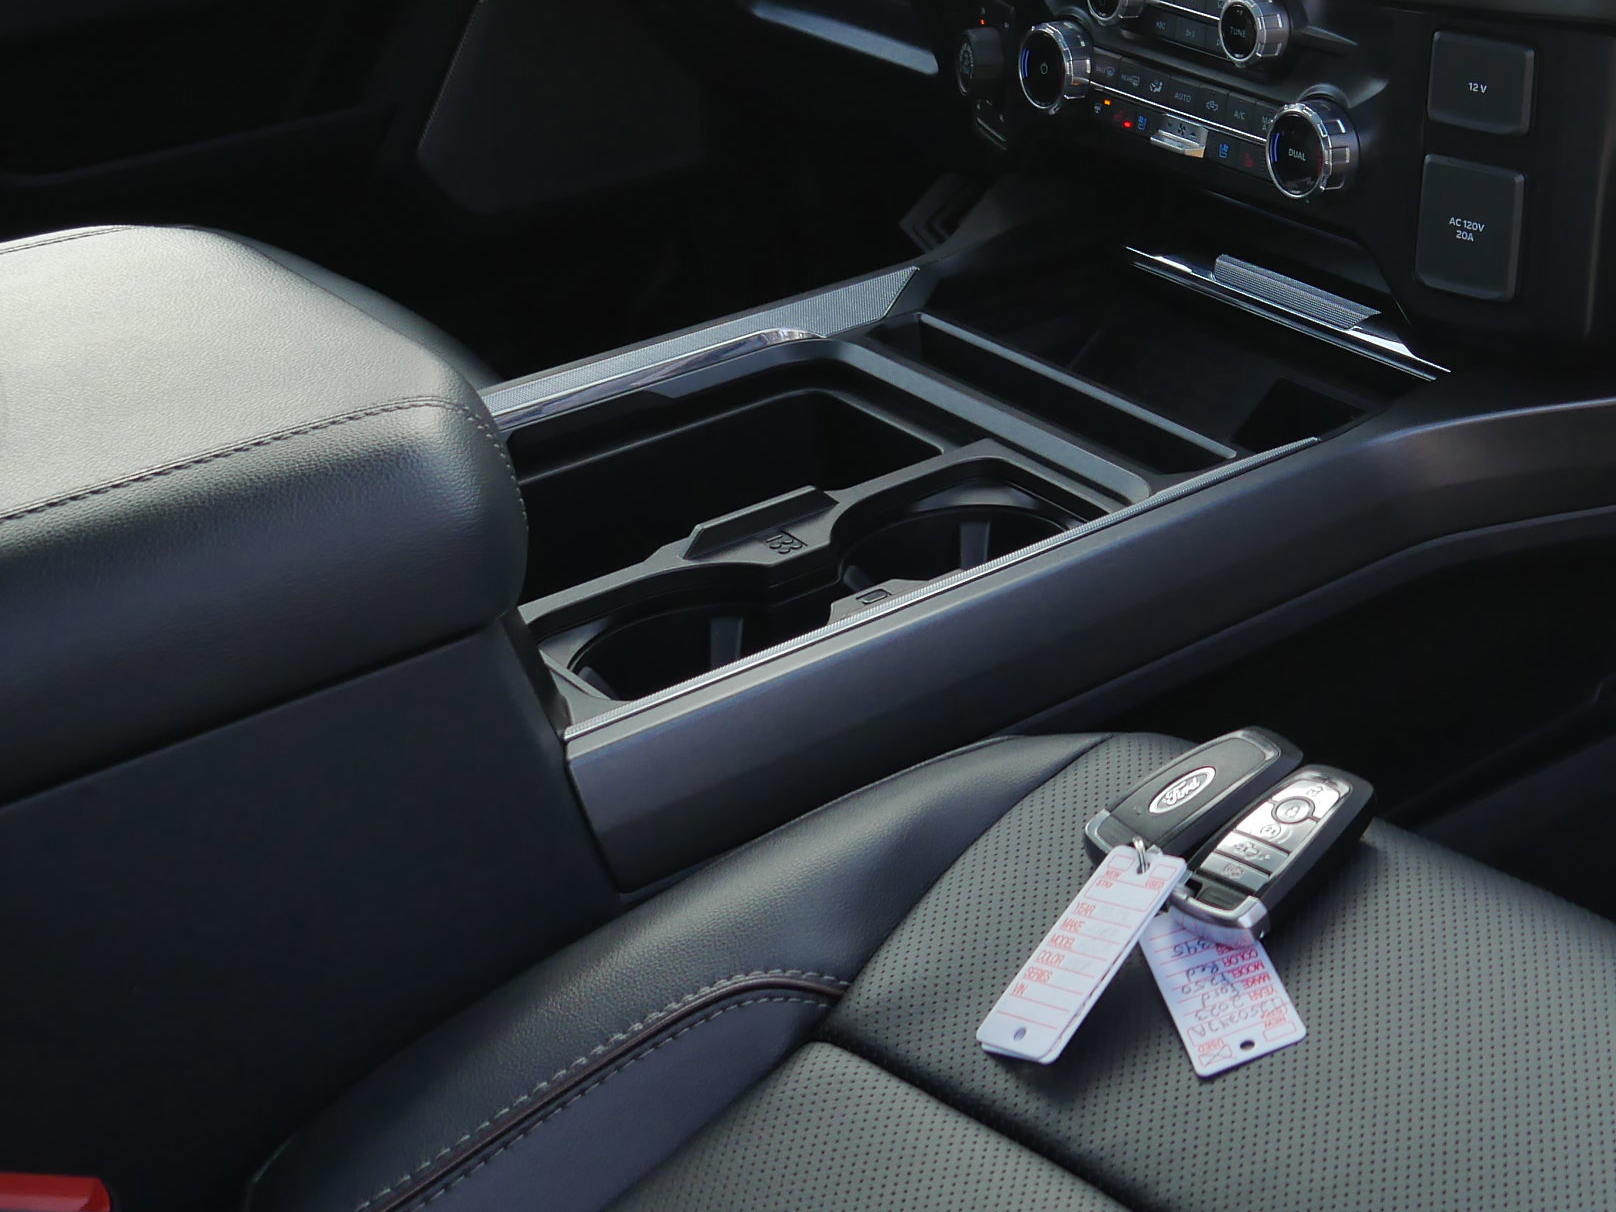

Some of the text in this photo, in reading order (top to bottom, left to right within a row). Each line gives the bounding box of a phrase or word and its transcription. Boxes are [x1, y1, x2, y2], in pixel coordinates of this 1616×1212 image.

[1468, 82, 1488, 94] 12 V
[1173, 91, 1192, 103] AUTO
[1233, 109, 1246, 122] A/C
[1288, 148, 1307, 162] DUAL
[1448, 216, 1485, 233] AC 120V
[1455, 229, 1474, 242] 20A
[1073, 902, 1096, 916] YEAR
[1061, 918, 1085, 933] MAKE
[1048, 934, 1077, 950] MODEL
[1035, 950, 1065, 965] COLOR
[1222, 948, 1259, 967] COLOR
[1186, 963, 1219, 982] Red
[1231, 960, 1265, 977] MODEL
[1241, 972, 1272, 988] MAKE
[1250, 985, 1276, 1001] YEAR
